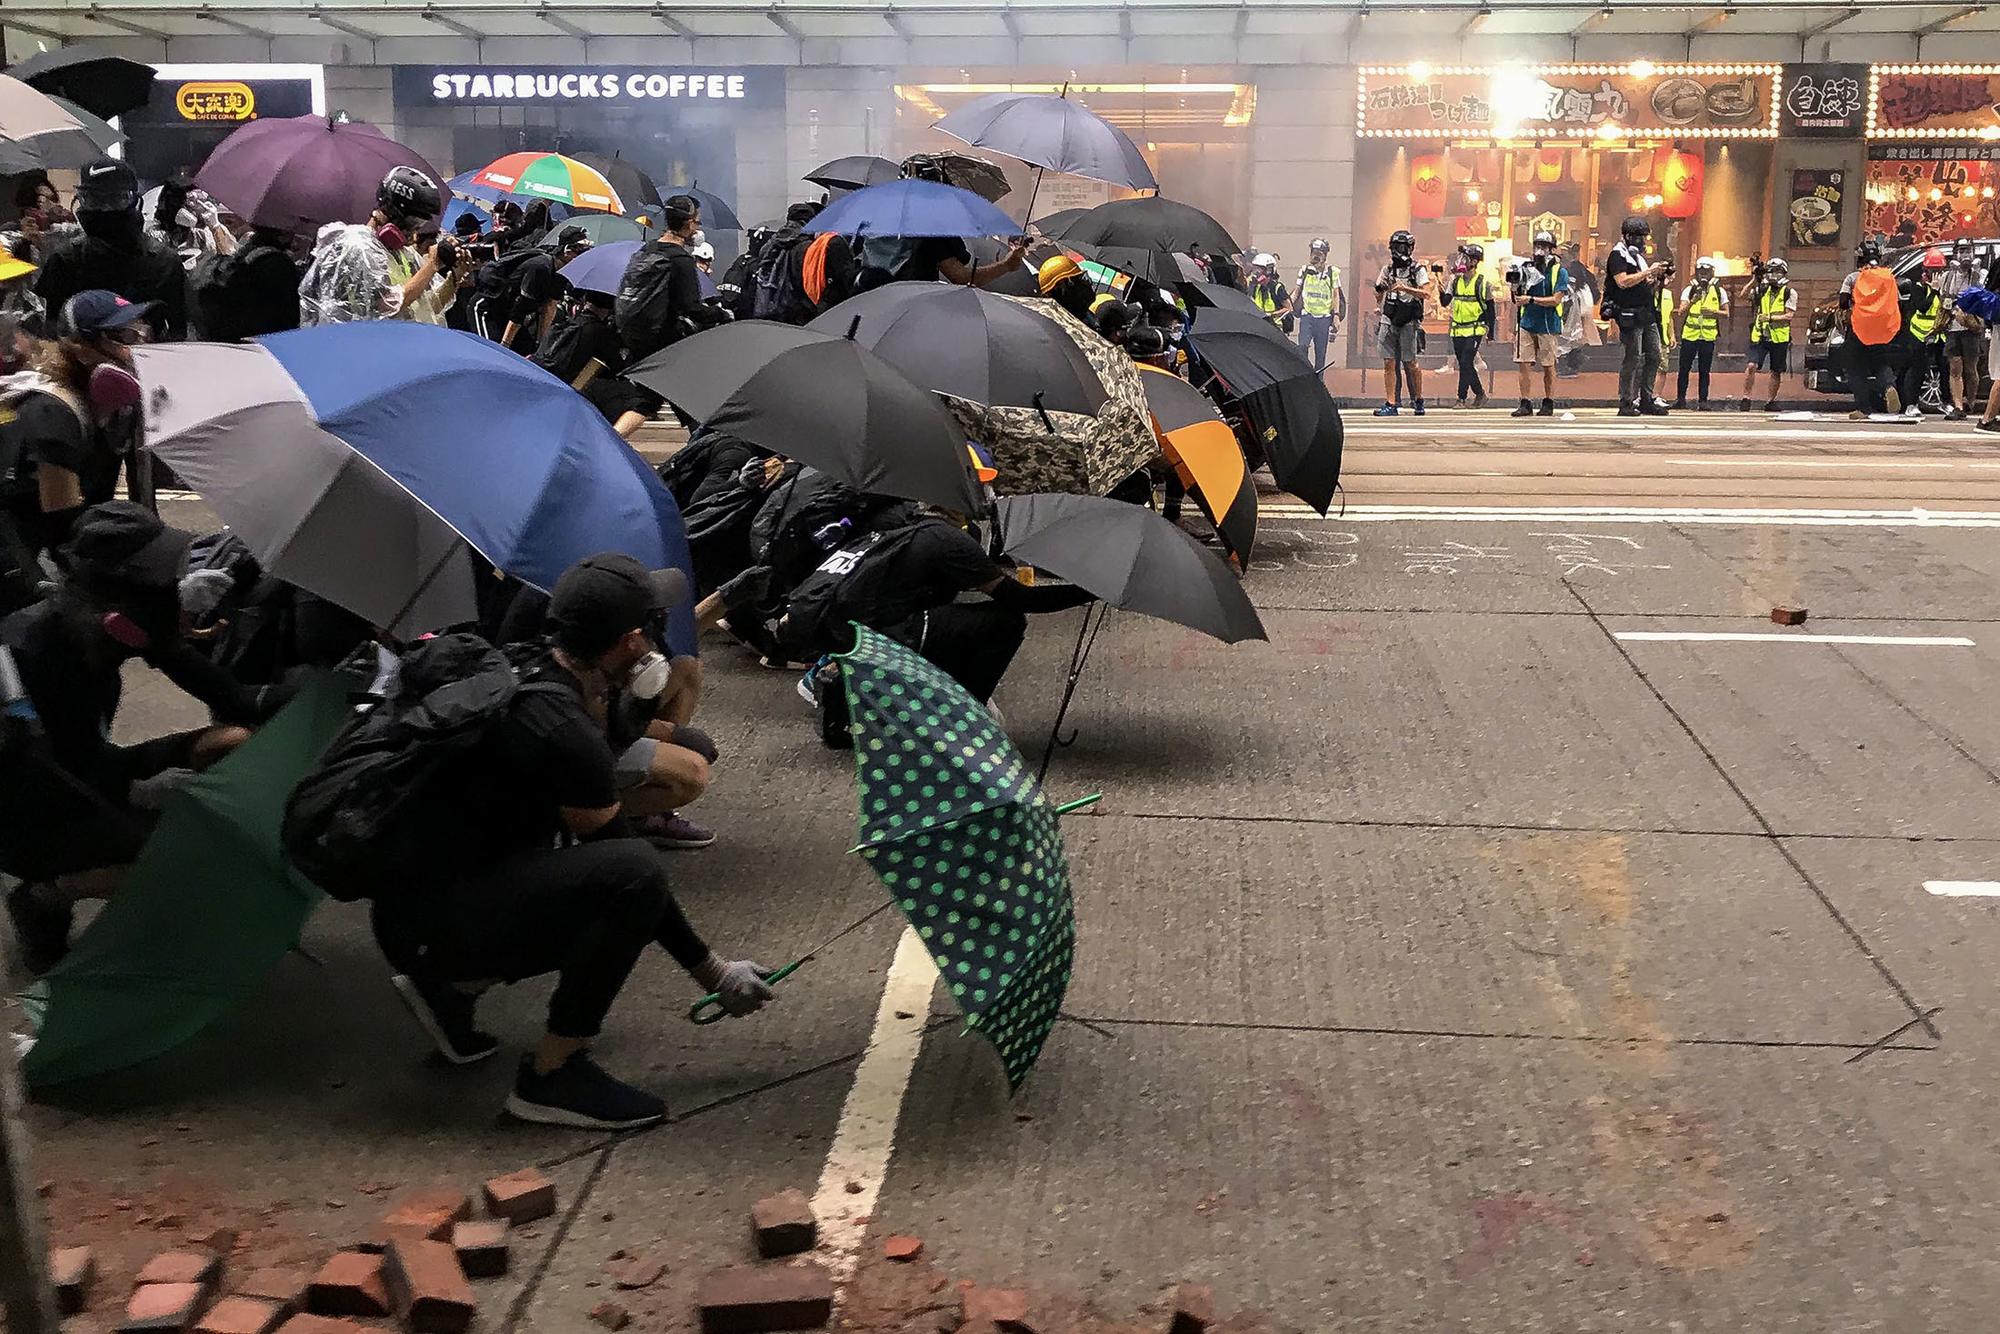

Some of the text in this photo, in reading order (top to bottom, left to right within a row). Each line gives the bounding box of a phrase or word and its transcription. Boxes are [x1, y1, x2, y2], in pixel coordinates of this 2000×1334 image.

[432, 74, 745, 99] STARBUCKS COFFEE
[187, 92, 243, 114] 大家樂
